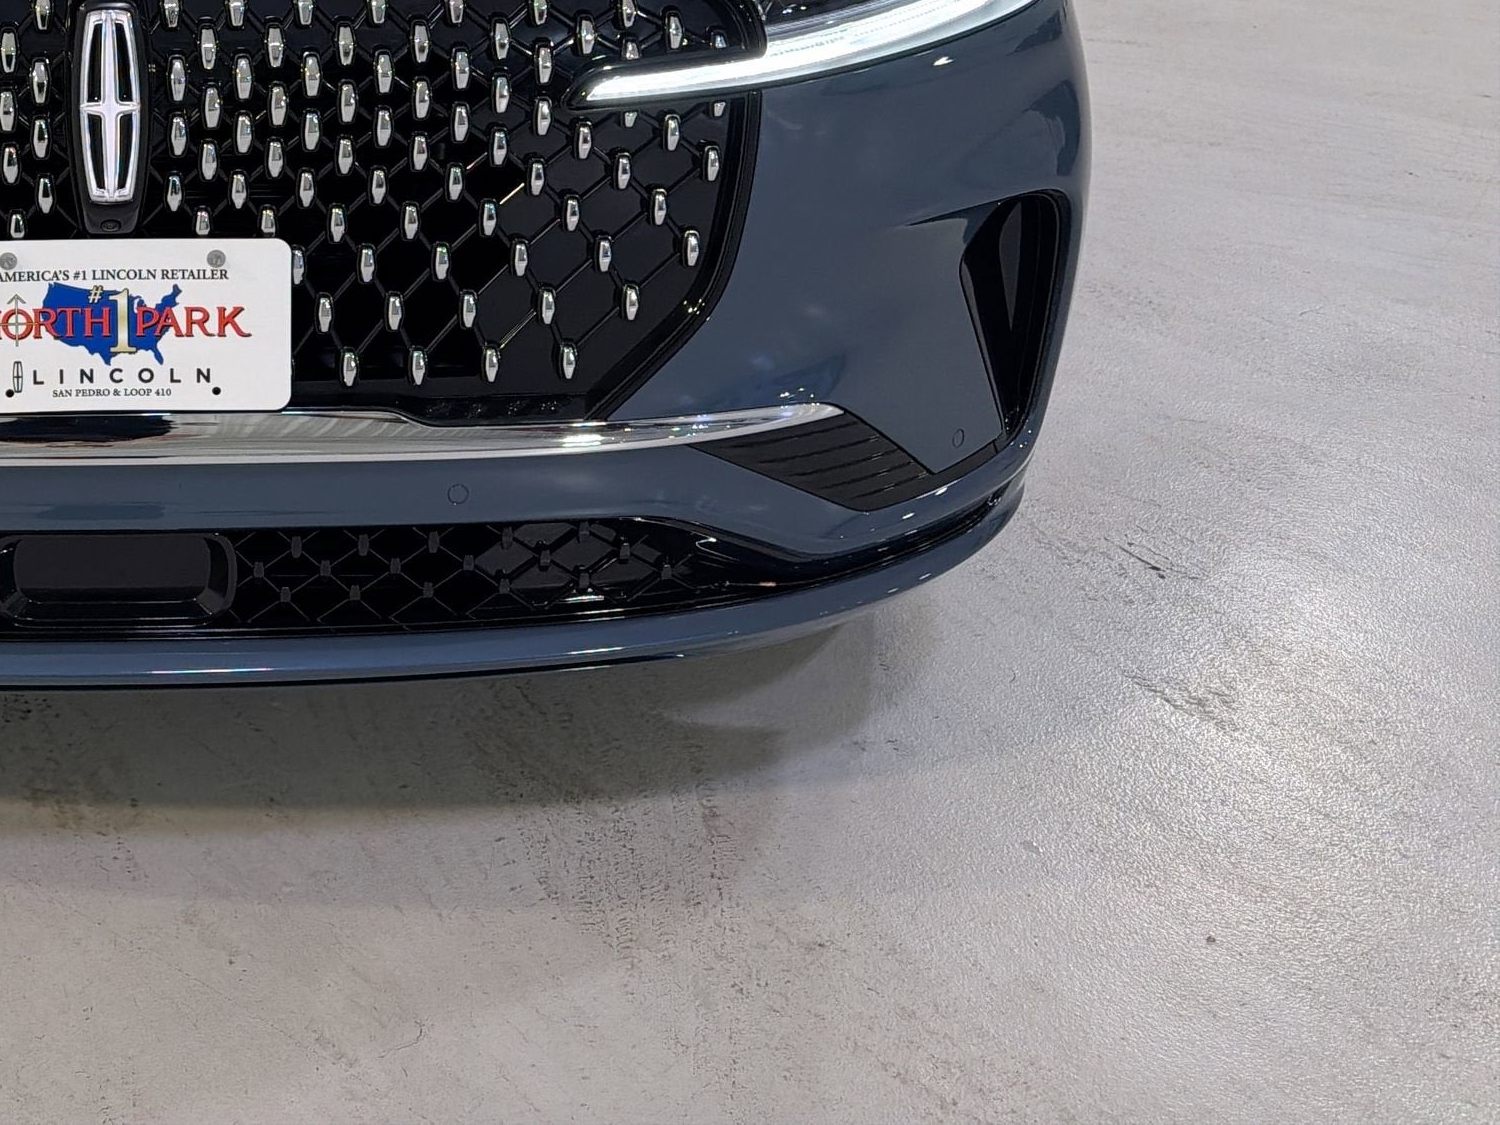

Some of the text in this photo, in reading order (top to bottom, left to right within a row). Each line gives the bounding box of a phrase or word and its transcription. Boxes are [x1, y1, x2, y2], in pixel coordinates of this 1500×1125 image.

[73, 270, 88, 281] #1
[91, 269, 157, 281] LINCOLN
[161, 268, 229, 280] RETAILER
[136, 306, 253, 338] PARK
[32, 367, 211, 385] LINCOLN
[52, 387, 172, 398] SAN PEDRO & LOOP 410
